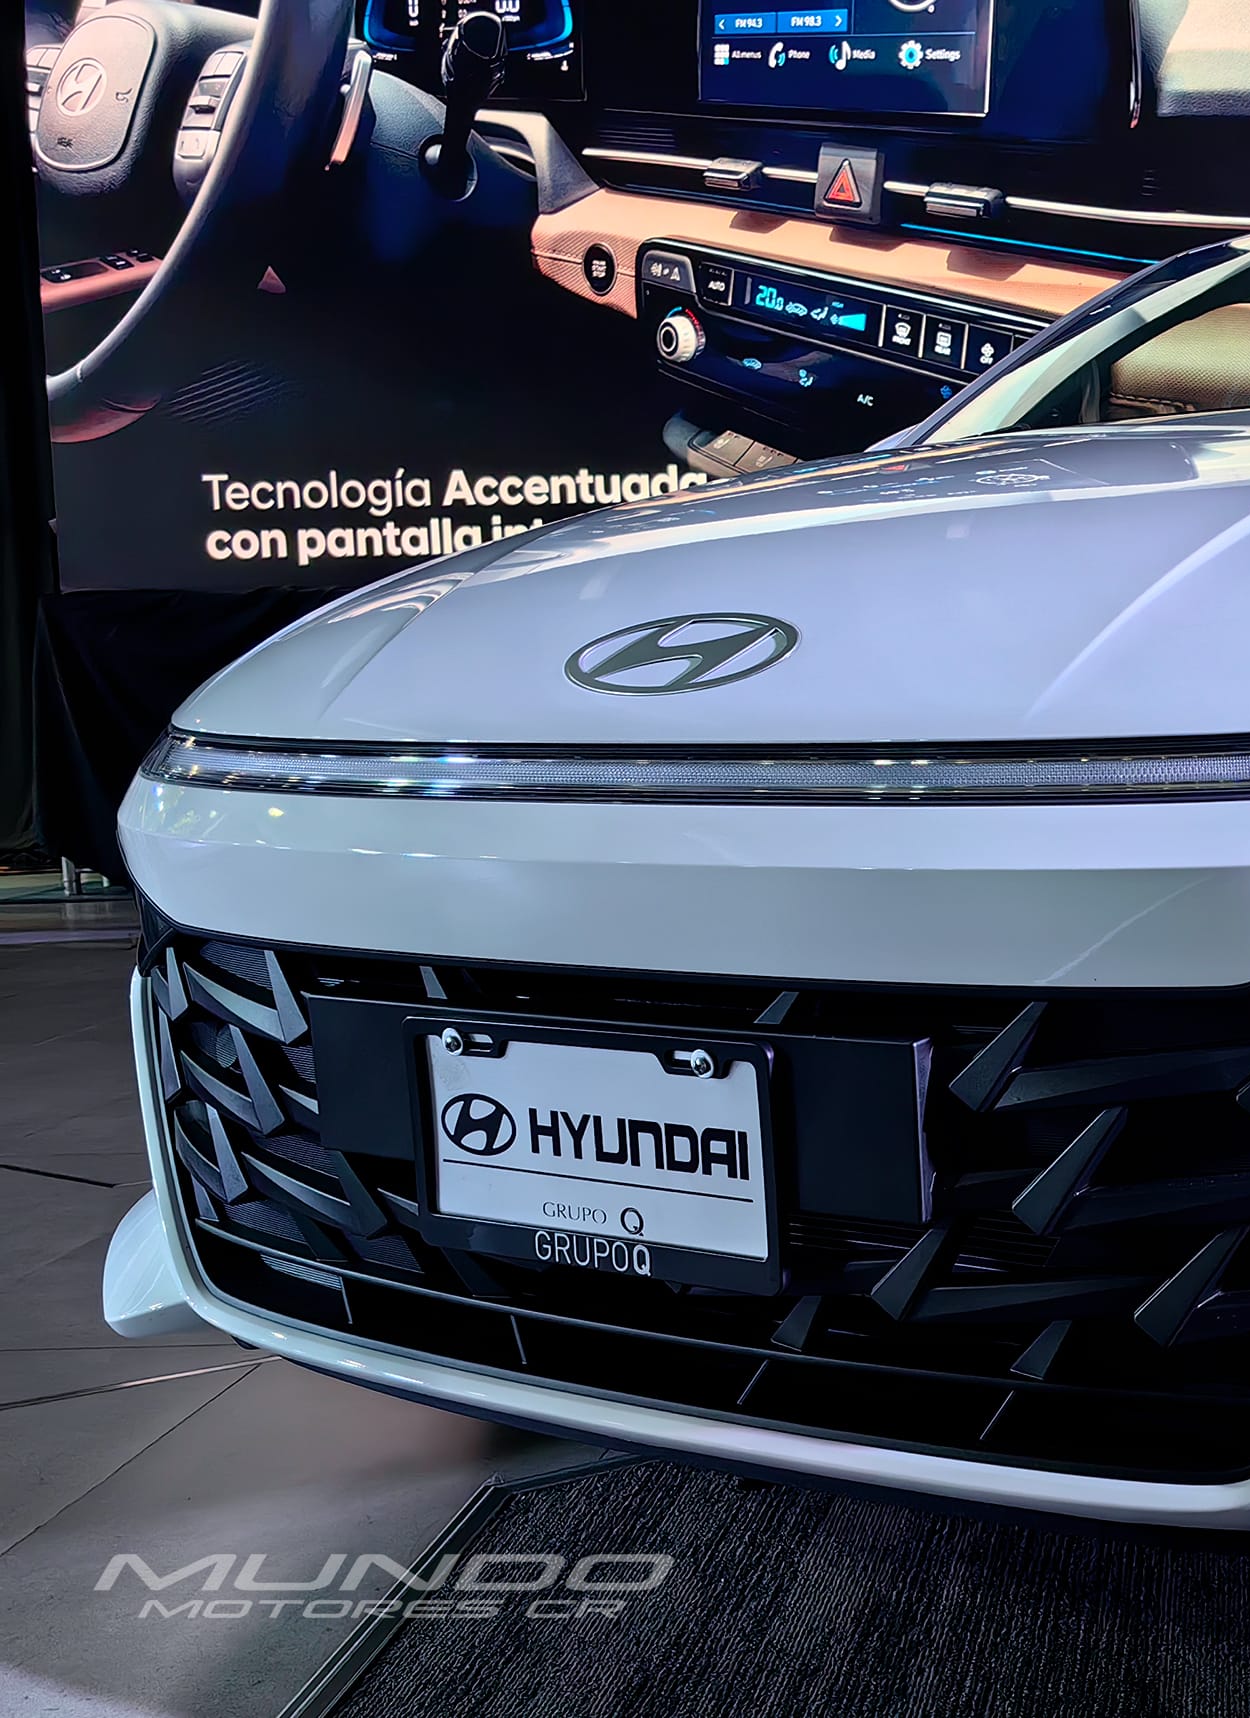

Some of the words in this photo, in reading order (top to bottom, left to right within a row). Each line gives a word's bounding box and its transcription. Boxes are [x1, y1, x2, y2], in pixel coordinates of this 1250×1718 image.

[925, 48, 961, 62] Settings
[708, 280, 726, 292] AUTO
[857, 393, 874, 407] A/C
[201, 467, 431, 517] Tecnología
[206, 528, 288, 561] con
[297, 517, 483, 567] pantalla
[528, 1107, 750, 1181] HYUNDAI
[542, 1201, 608, 1225] GRUPO
[620, 1207, 644, 1237] Q
